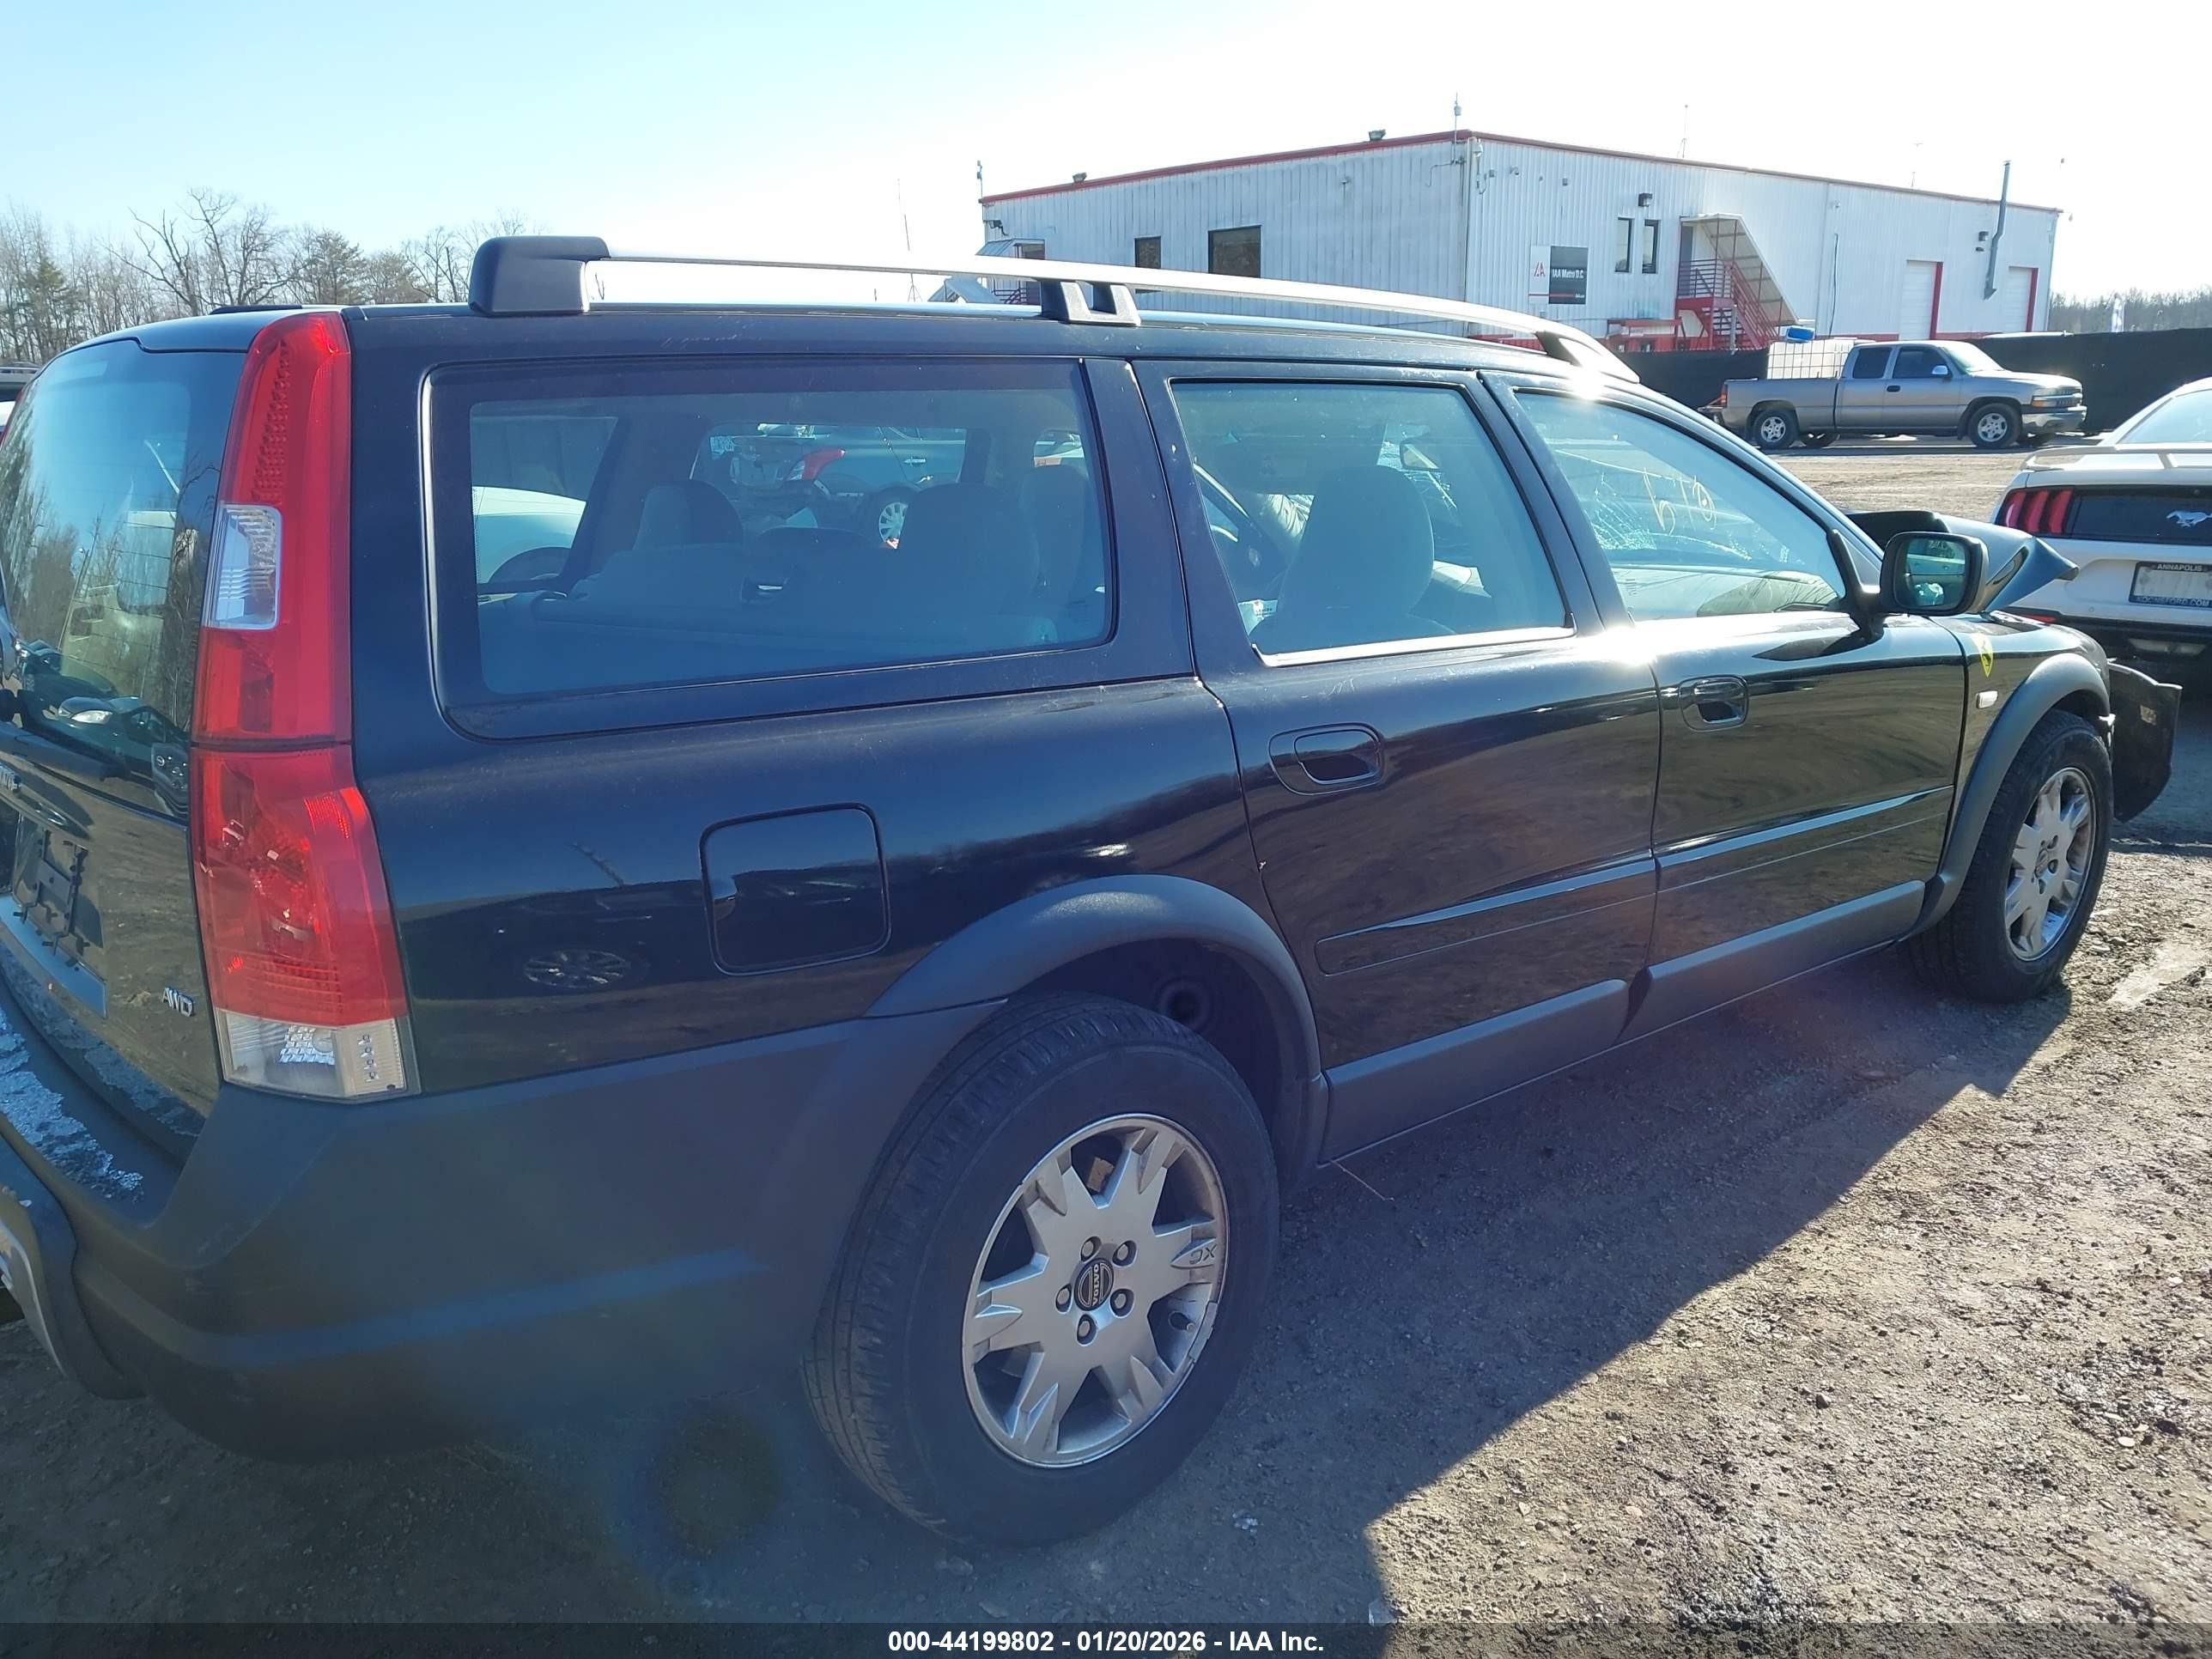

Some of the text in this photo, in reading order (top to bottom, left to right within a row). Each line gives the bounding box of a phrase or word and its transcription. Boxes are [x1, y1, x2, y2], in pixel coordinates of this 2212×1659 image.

[1552, 268, 1561, 278] IAA
[1562, 268, 1576, 279] Metro
[2157, 563, 2203, 572] ANNAPOLIS
[161, 987, 193, 1018] AWD
[1091, 1264, 1101, 1307] VOLVO
